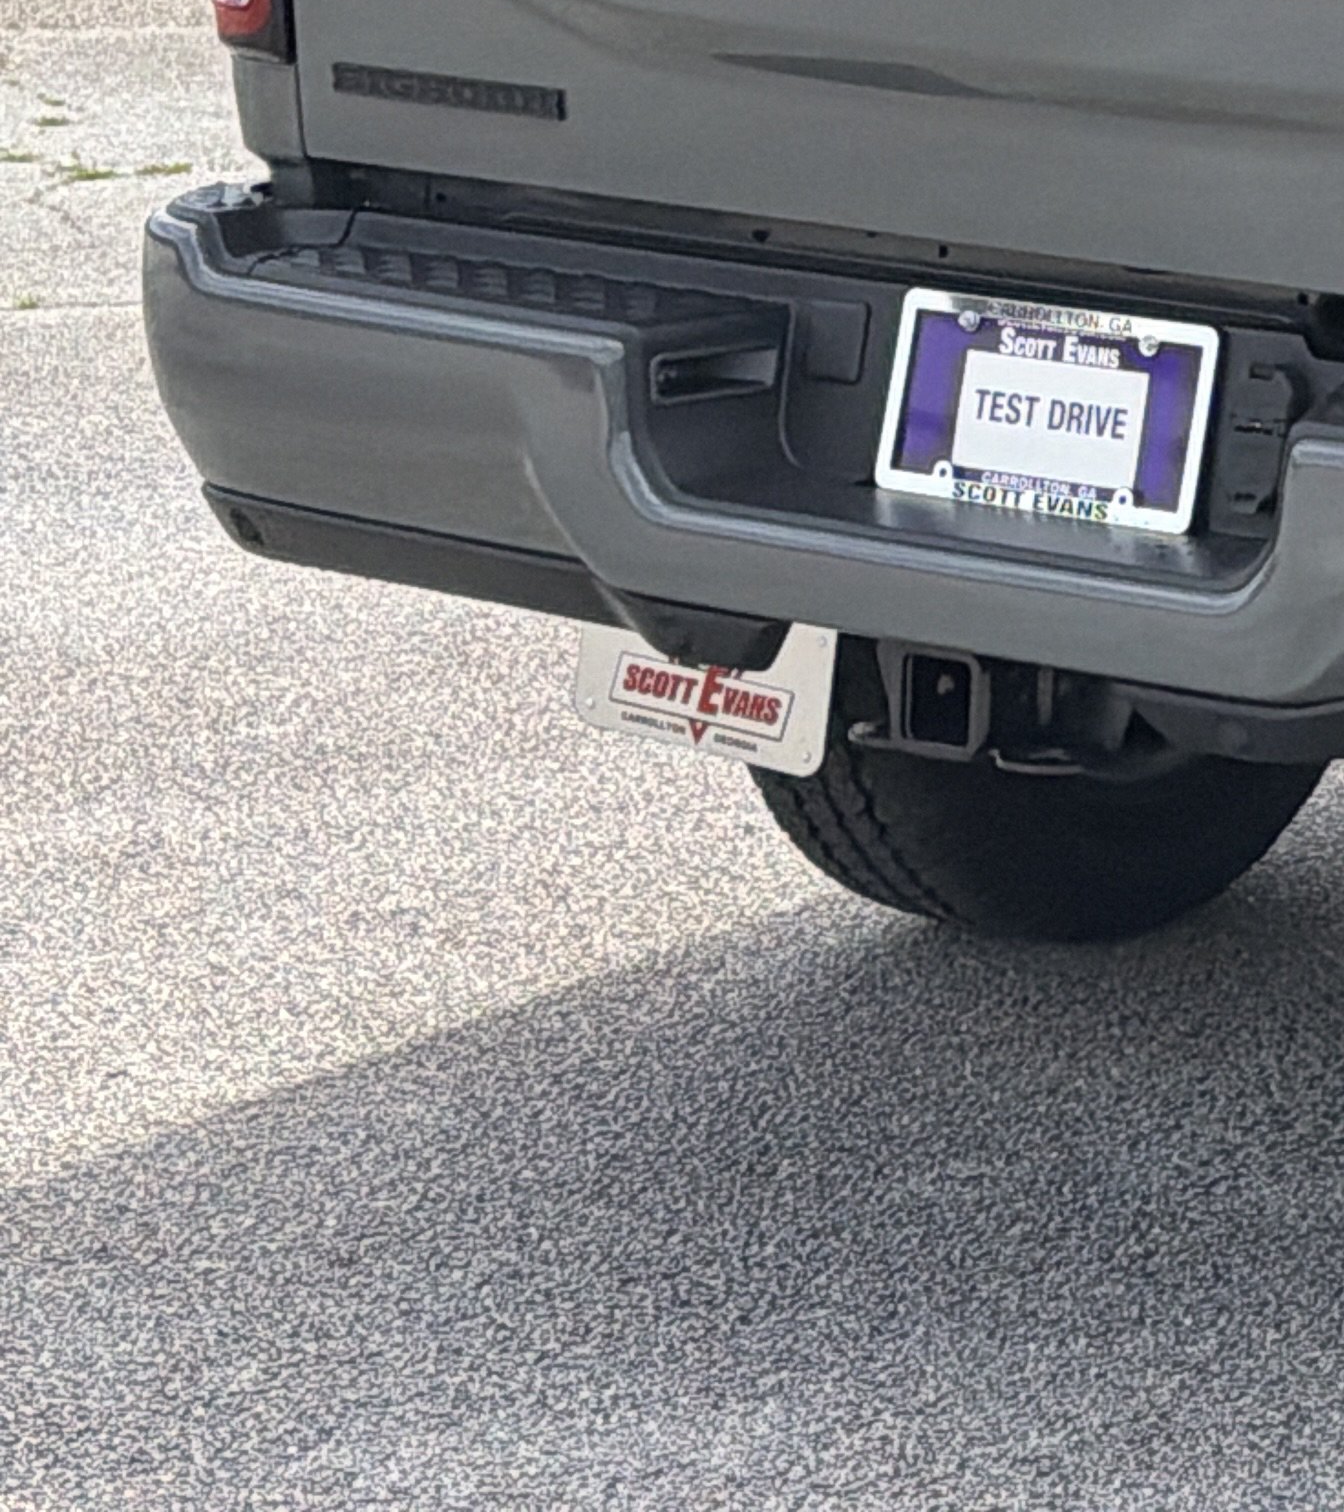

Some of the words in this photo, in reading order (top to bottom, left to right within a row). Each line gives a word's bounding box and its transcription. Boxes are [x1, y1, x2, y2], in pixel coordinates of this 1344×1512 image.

[1109, 317, 1133, 334] GA
[999, 326, 1057, 360] SCOTT
[1063, 336, 1121, 369] EVANS
[975, 388, 1041, 428] TEST
[1047, 398, 1129, 440] DRIVE
[952, 482, 1026, 509] SCOTT
[1032, 493, 1109, 521] EVANS
[1077, 485, 1098, 499] GA
[623, 663, 699, 705] SCOTT
[696, 664, 782, 726] EVANS
